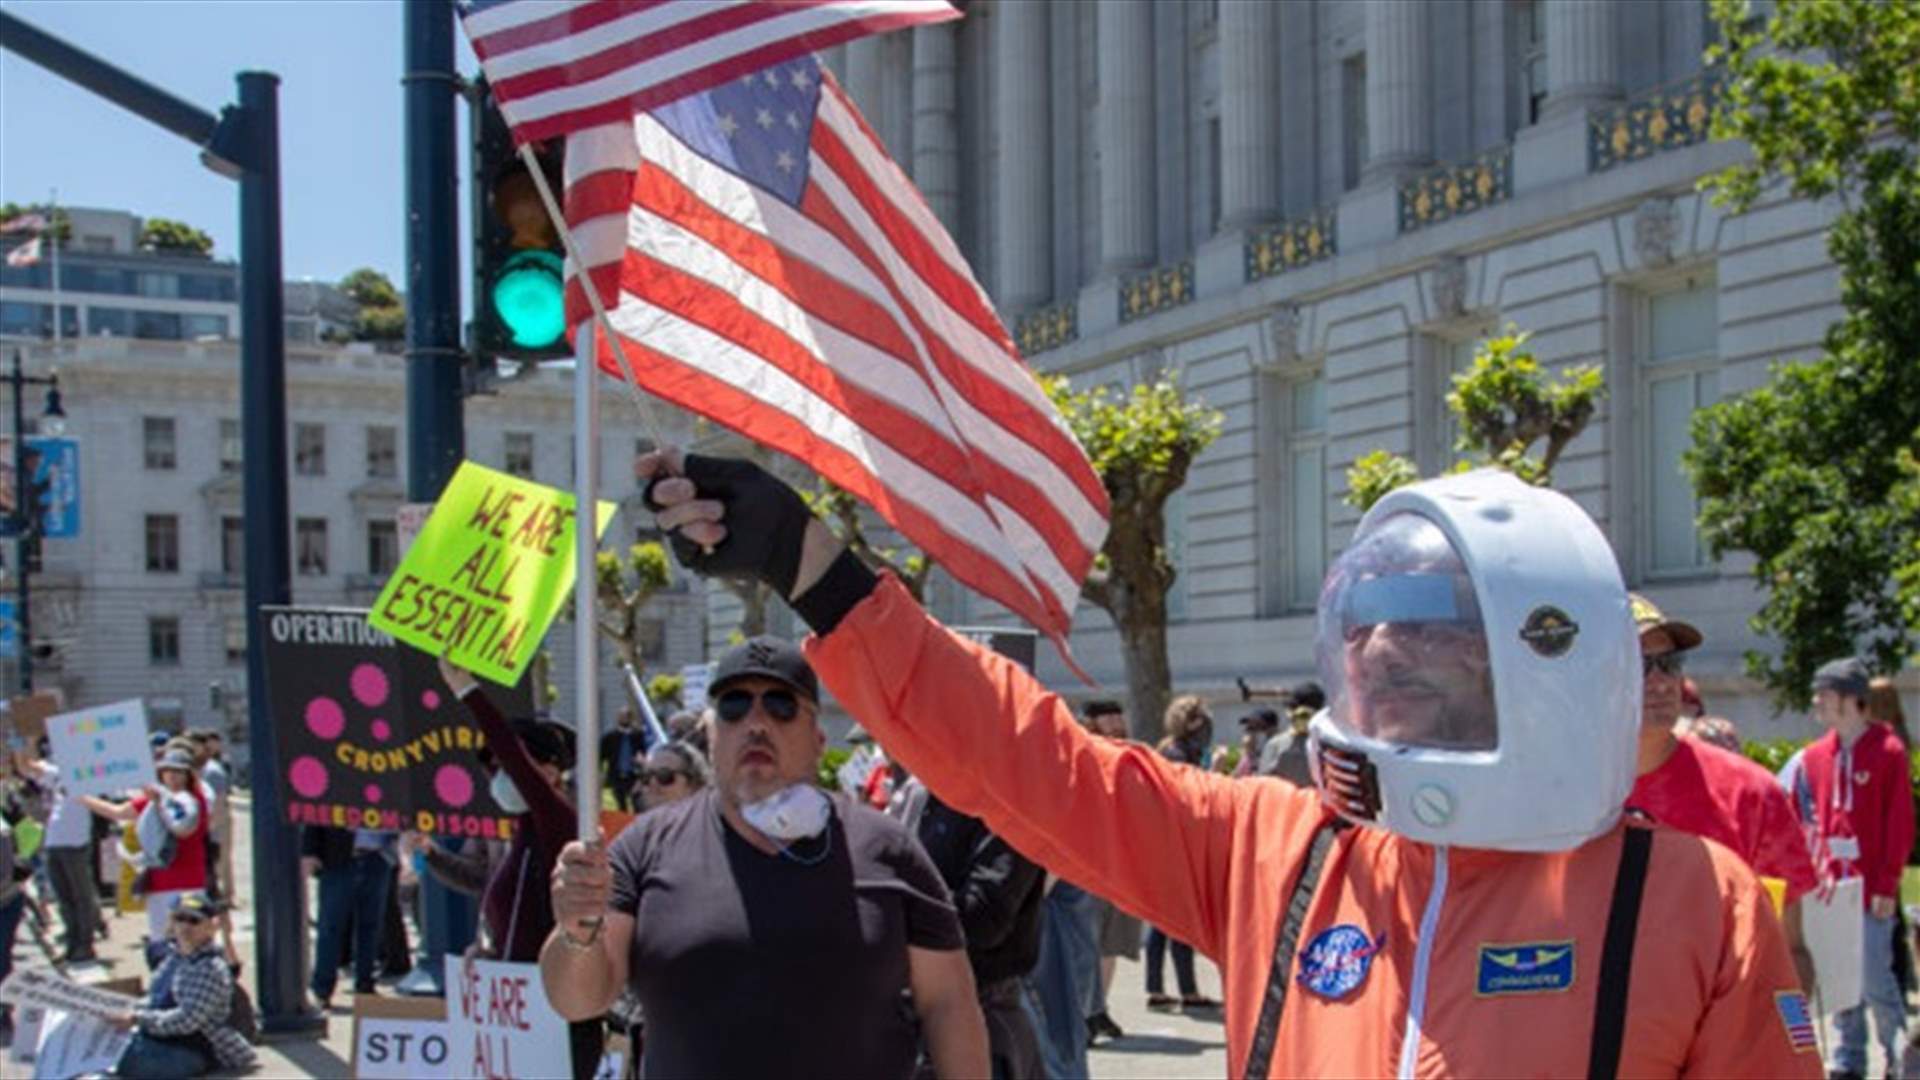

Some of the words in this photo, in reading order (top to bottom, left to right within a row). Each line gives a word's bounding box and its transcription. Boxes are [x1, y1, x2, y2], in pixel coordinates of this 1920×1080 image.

[467, 485, 525, 538] WE
[511, 502, 577, 556] ARE
[451, 543, 522, 603] ALL
[383, 574, 531, 671] ESSENTIAL
[416, 809, 519, 839] DISOBE
[487, 976, 532, 1032] ARE
[366, 1032, 448, 1064] STO
